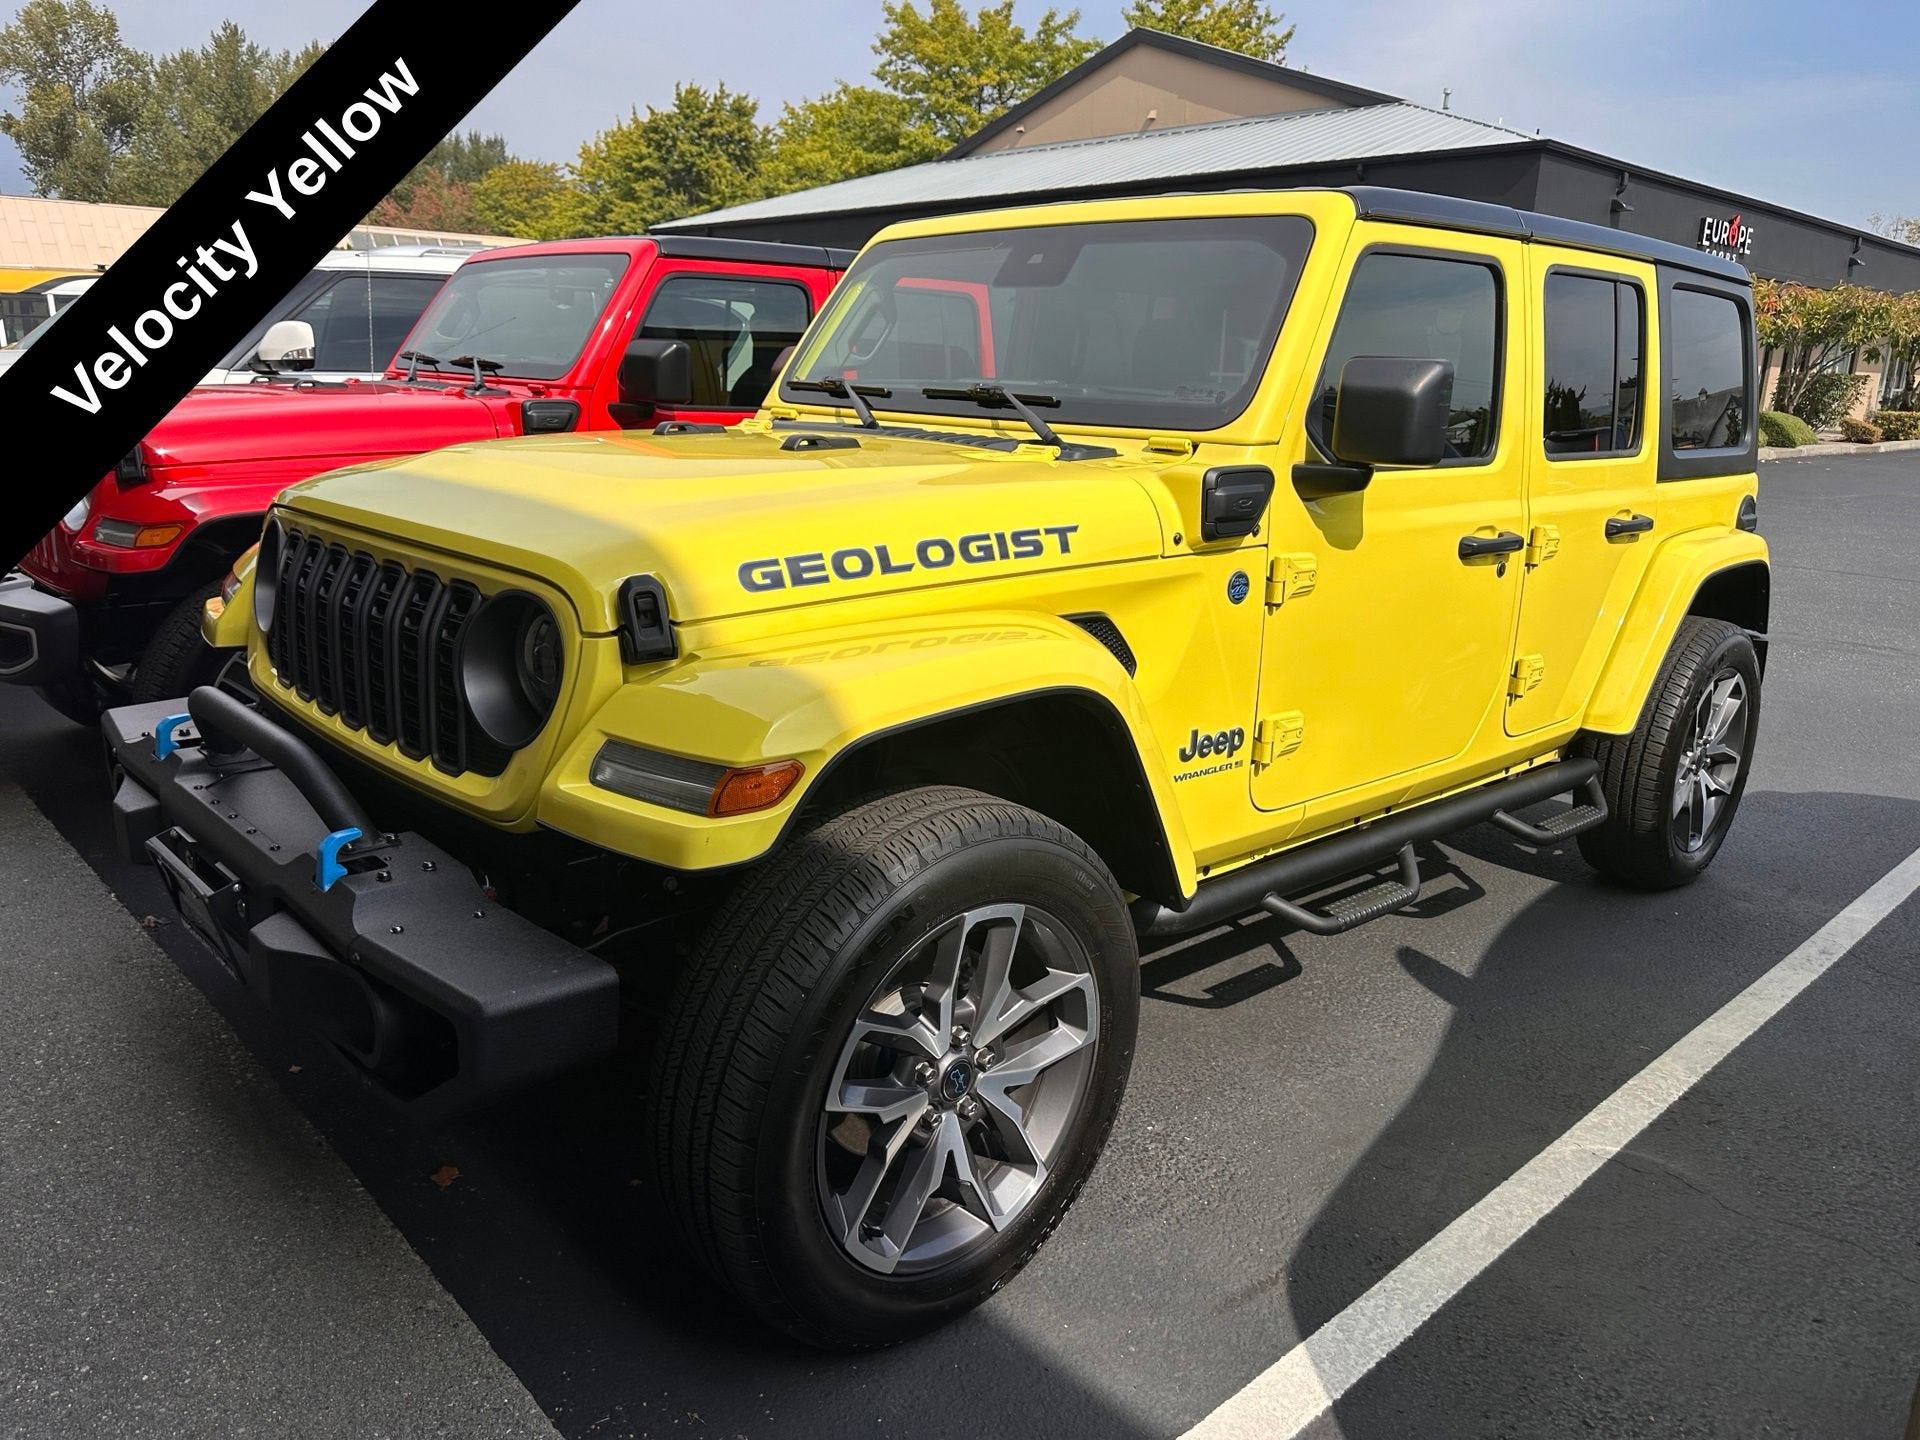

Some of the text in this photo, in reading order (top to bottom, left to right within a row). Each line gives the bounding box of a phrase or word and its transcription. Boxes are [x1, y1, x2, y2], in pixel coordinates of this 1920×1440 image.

[1702, 215, 1754, 255] EUROPE
[737, 524, 1080, 593] GEOLOGIST
[1179, 727, 1245, 763] Jeep
[1173, 762, 1233, 783] WRANGLER
